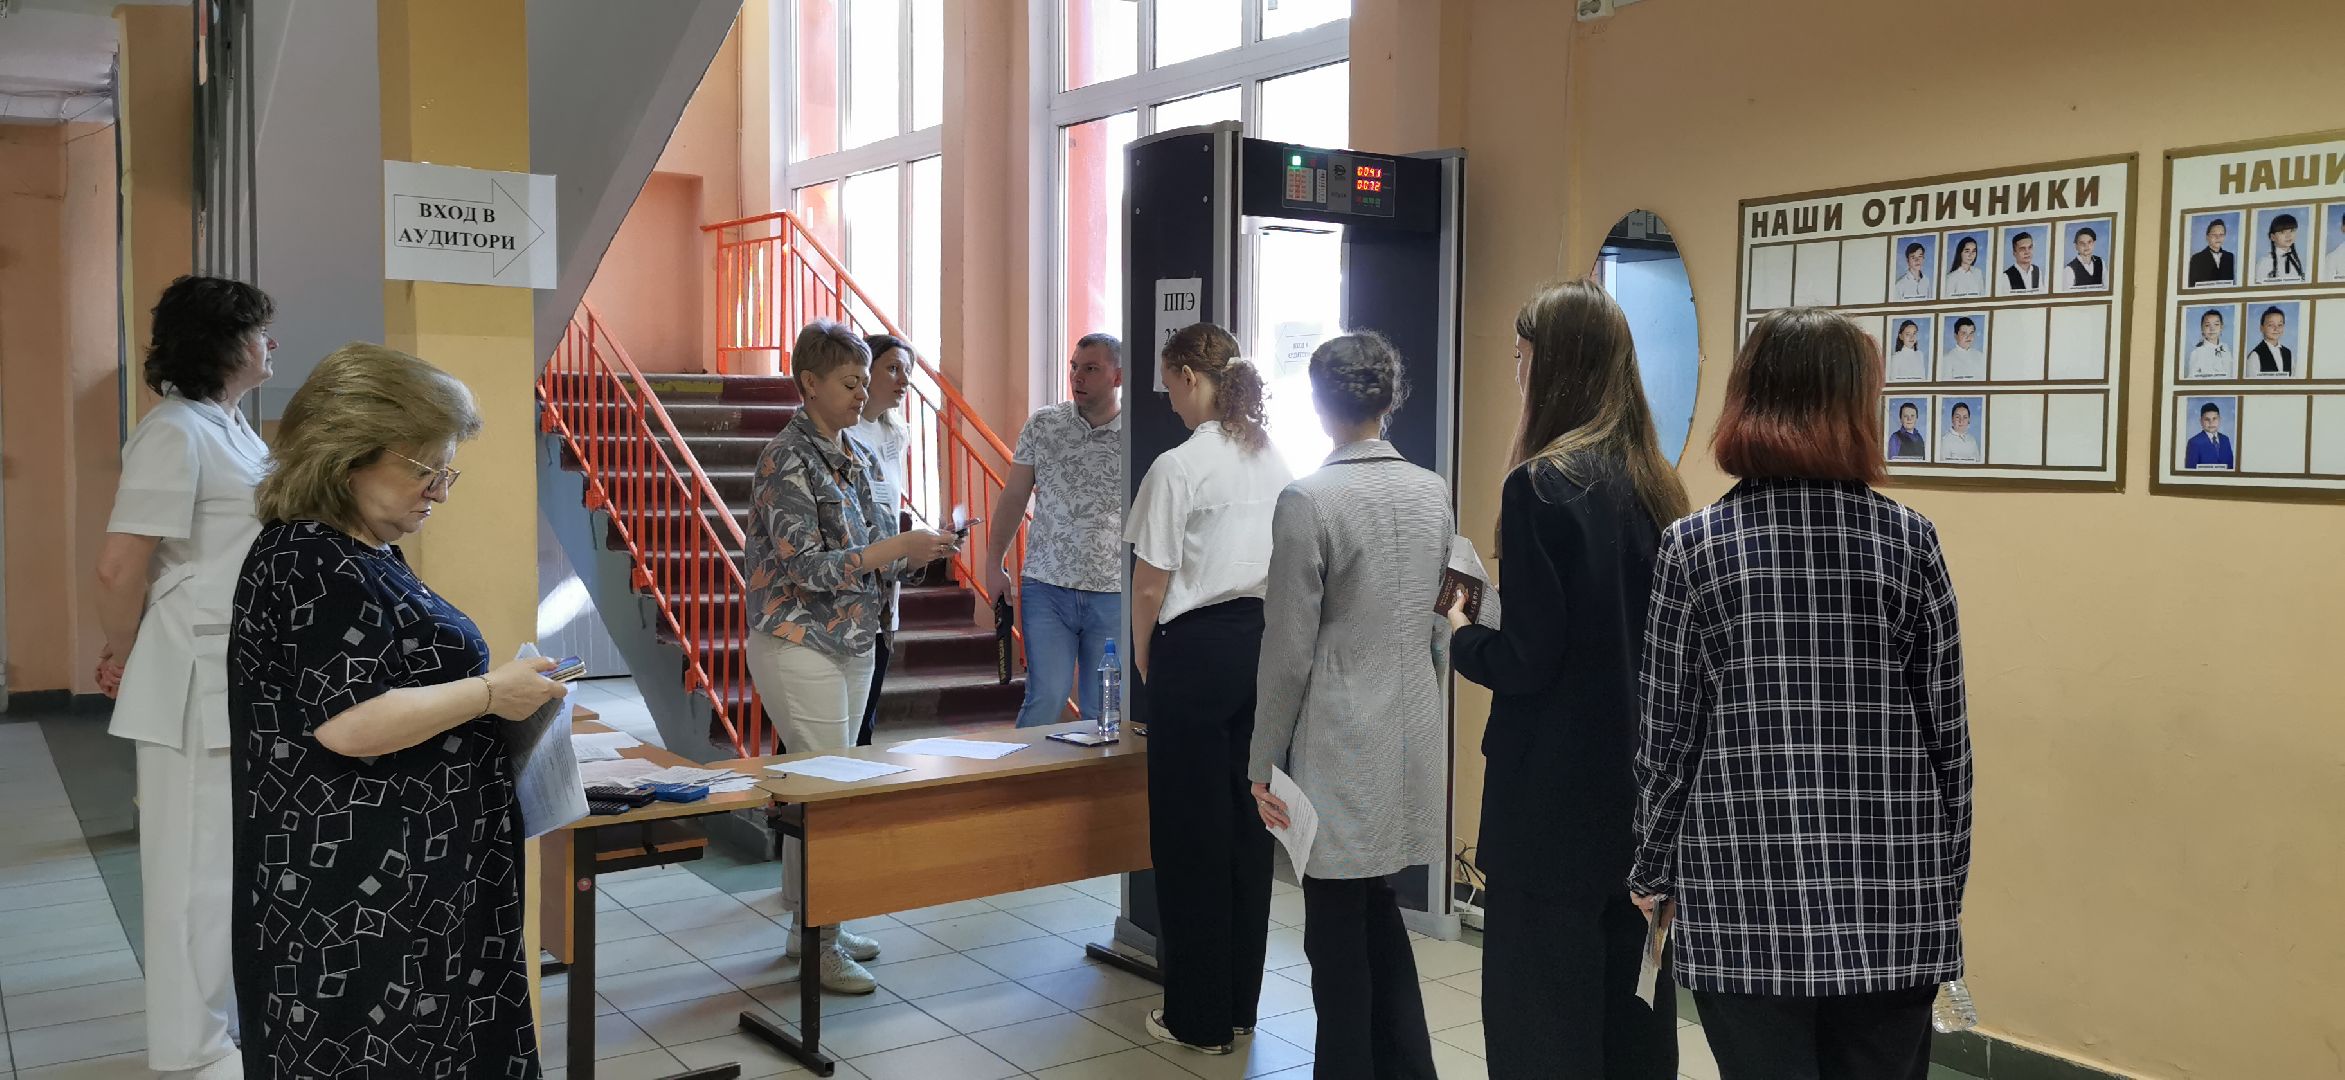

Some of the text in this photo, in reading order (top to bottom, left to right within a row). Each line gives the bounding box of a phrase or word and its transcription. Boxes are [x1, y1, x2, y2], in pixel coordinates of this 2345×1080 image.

[2219, 152, 2345, 194] НАШИ
[419, 202, 495, 225] ВХОД В
[1751, 175, 2101, 238] НАШИ ОТЛИЧНИКИ
[398, 228, 515, 250] АУДИТОРИ
[1163, 292, 1195, 311] ППЭ
